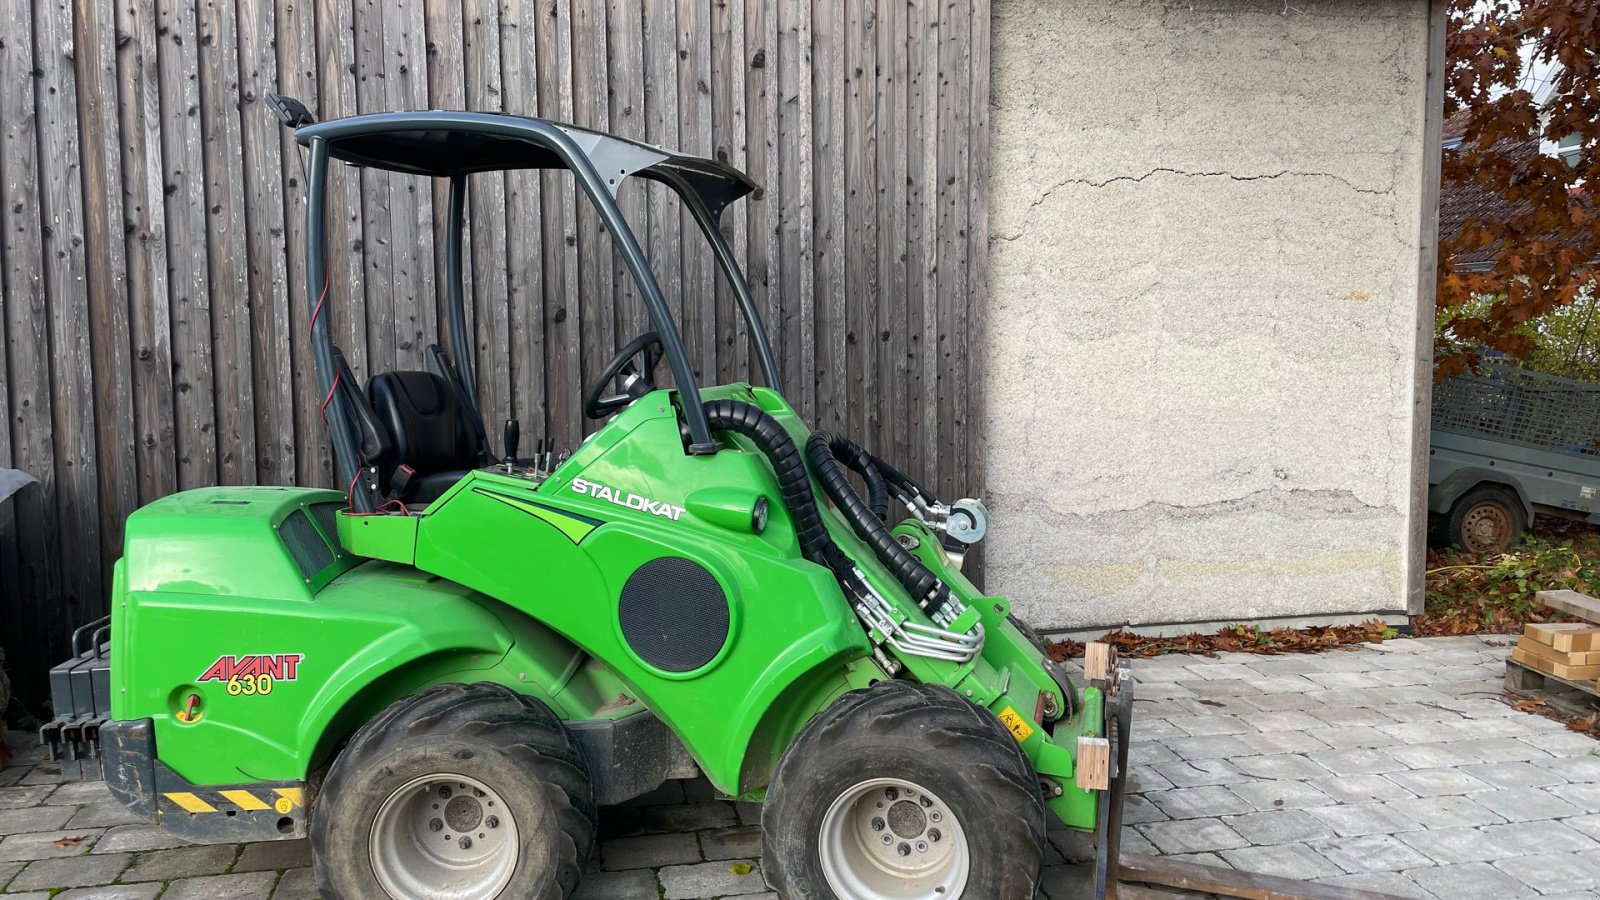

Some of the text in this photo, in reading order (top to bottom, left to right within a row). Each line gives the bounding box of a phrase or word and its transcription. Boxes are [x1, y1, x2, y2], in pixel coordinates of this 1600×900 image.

[571, 477, 687, 521] STALDKAT
[196, 654, 302, 682] AVANT
[226, 673, 273, 696] 630
